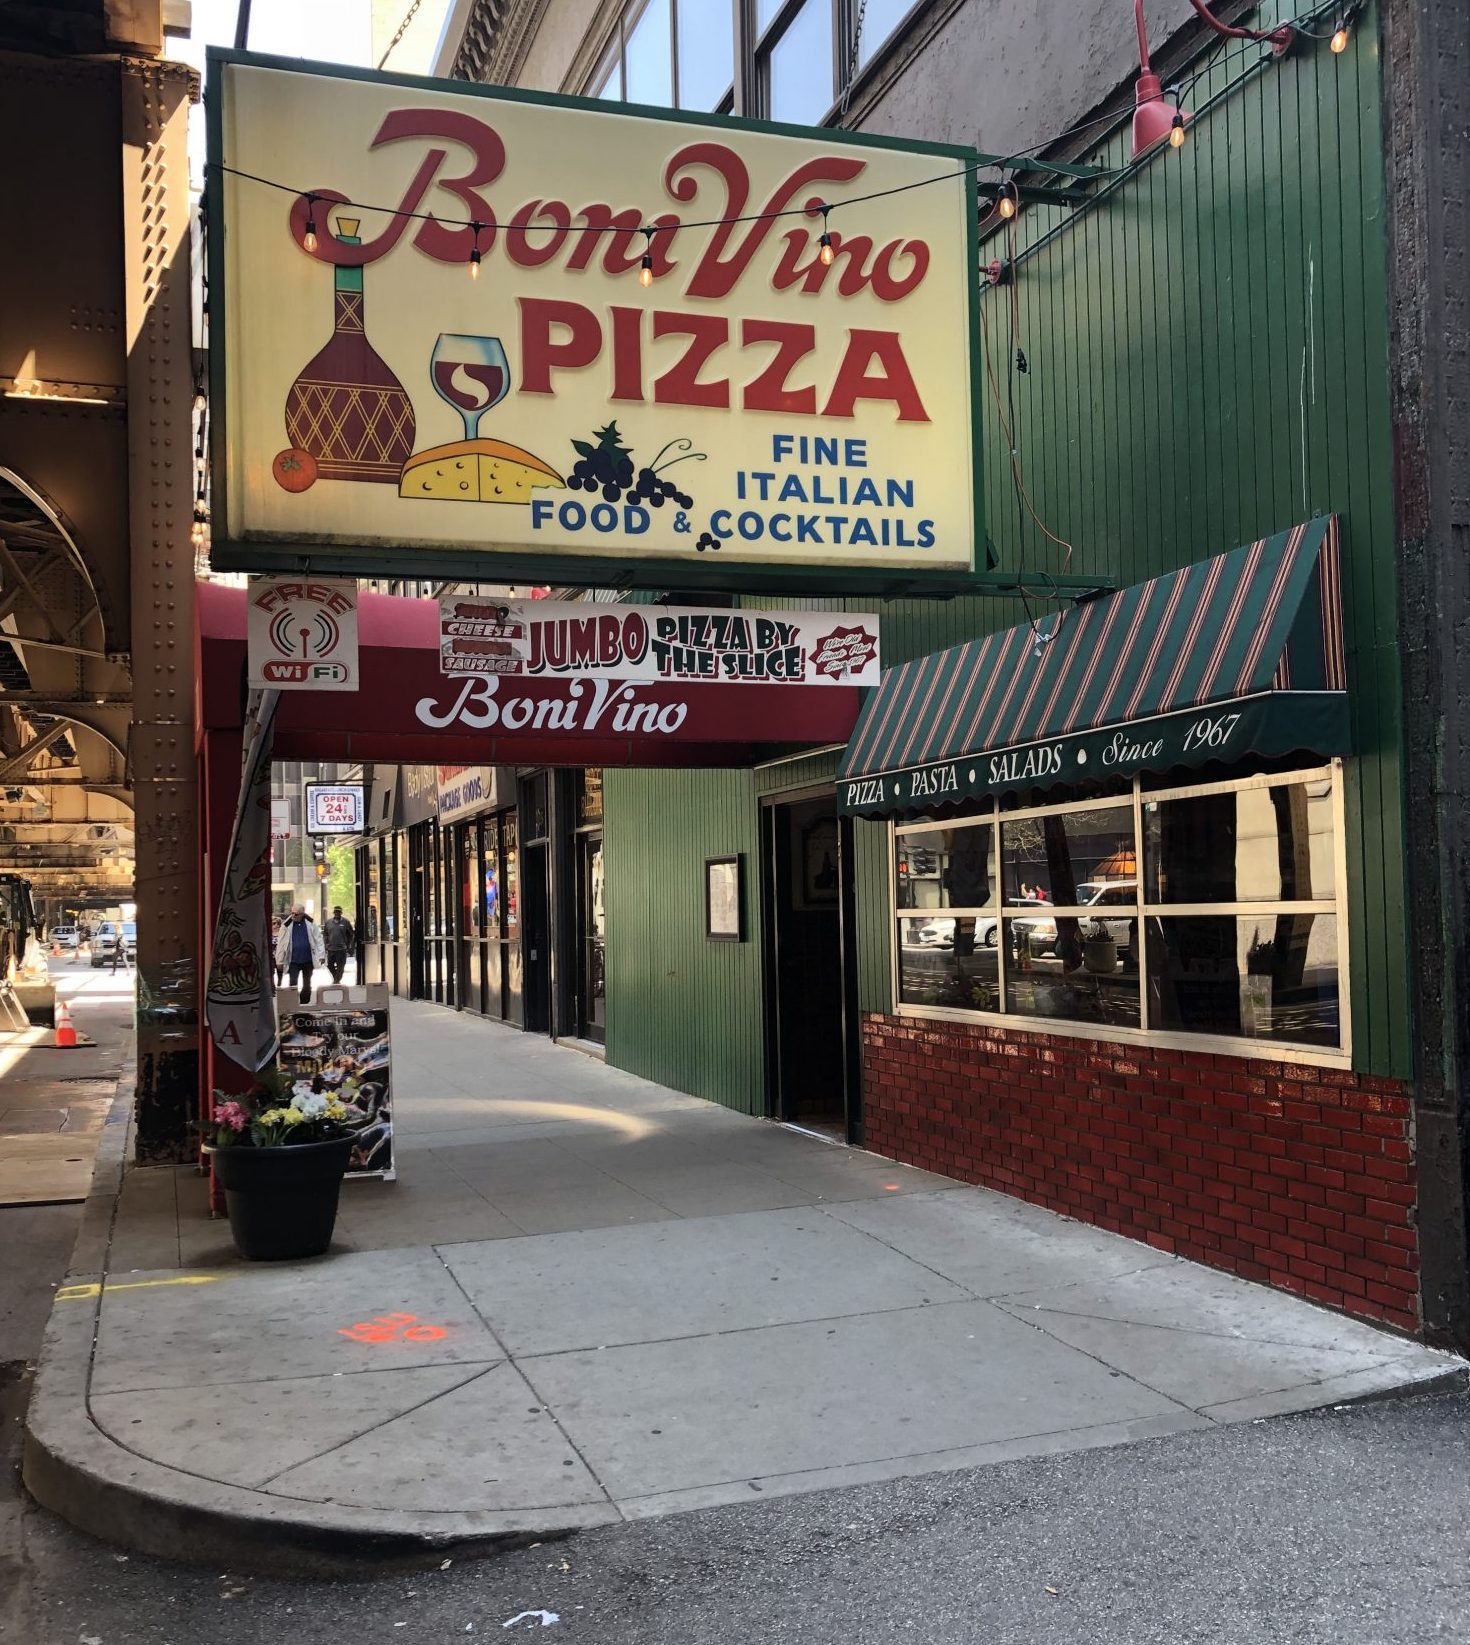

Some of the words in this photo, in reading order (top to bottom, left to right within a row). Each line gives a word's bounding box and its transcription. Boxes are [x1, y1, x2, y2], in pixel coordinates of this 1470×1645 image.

[290, 107, 680, 279] Boni
[664, 142, 931, 301] Vino
[516, 296, 931, 422] PIZZA
[772, 434, 867, 468] FINE
[736, 470, 914, 508] ITALIAN
[531, 500, 651, 536] FOOD
[672, 510, 692, 535] &
[710, 509, 936, 549] COCKTAILS
[254, 584, 354, 615] FREE
[447, 622, 515, 637] CHEESE
[527, 612, 648, 673] JUMBO
[656, 615, 752, 652] PIZZA
[755, 618, 799, 651] BY
[444, 657, 519, 672] SAUSAGE
[651, 638, 718, 678] THE
[721, 645, 804, 681] SLICE
[415, 675, 578, 729] Boni
[569, 678, 688, 732] Vino
[846, 779, 885, 806] PIZZA
[910, 764, 958, 798] PASTA
[988, 744, 1063, 785] SALADS
[1102, 732, 1163, 765] Since
[1183, 713, 1241, 752] 1967
[326, 803, 342, 813] 24
[295, 1017, 329, 1027] Come
[337, 1032, 357, 1040] our
